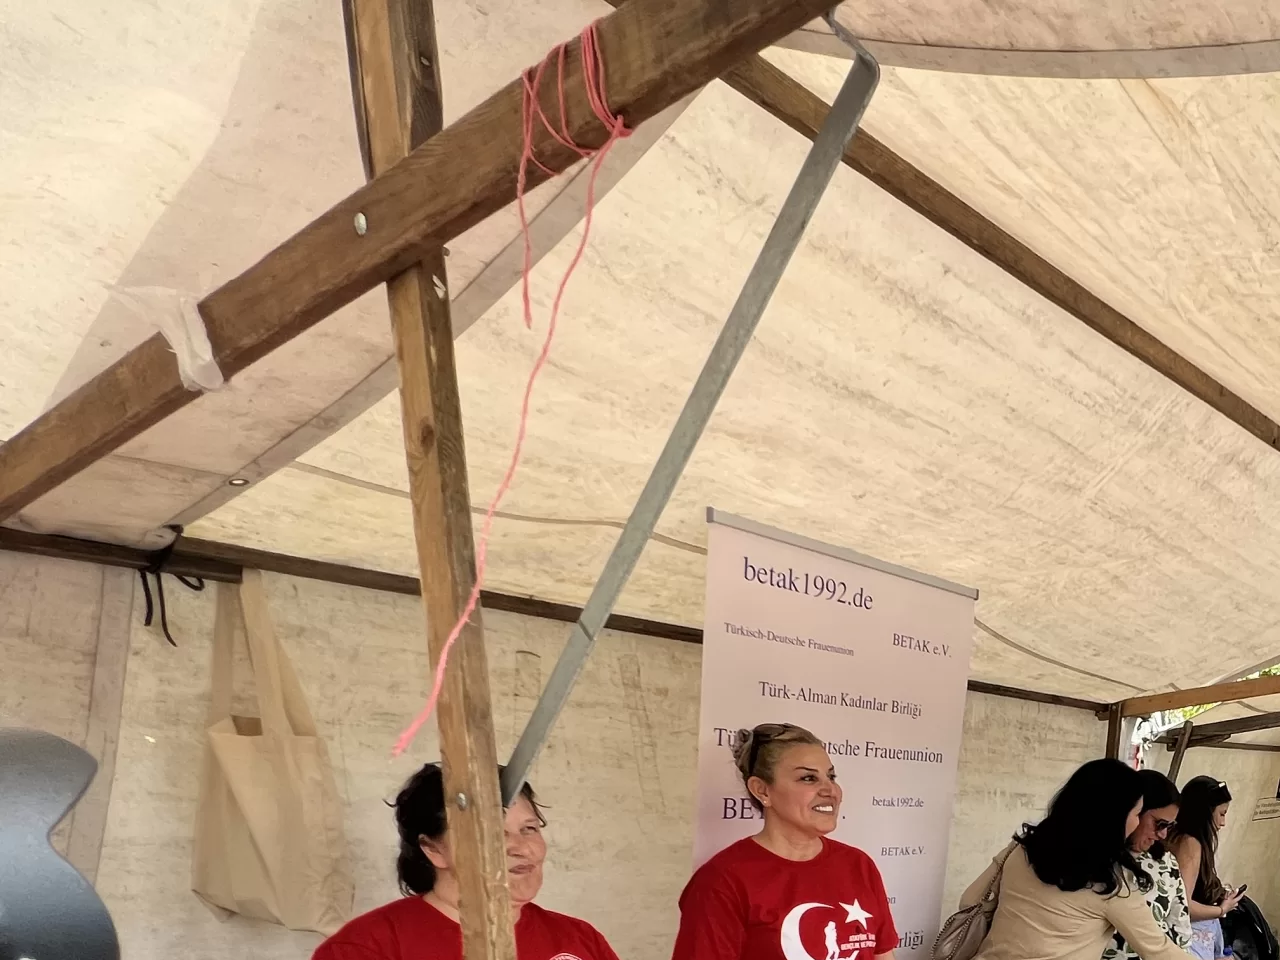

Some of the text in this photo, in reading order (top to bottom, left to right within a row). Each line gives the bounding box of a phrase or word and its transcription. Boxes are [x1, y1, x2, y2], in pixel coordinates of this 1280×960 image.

[743, 556, 873, 610] betak1992.de
[724, 622, 854, 656] Türkisch-Deutsche Frauenunion
[892, 633, 952, 657] BETAK e.V.
[759, 681, 922, 720] Türk-Alman Kadınlar Birliği
[865, 741, 943, 763] Frauenunion
[872, 796, 924, 808] betak1992.de
[881, 846, 926, 857] BETAK e.V.
[895, 930, 924, 950] rliği
